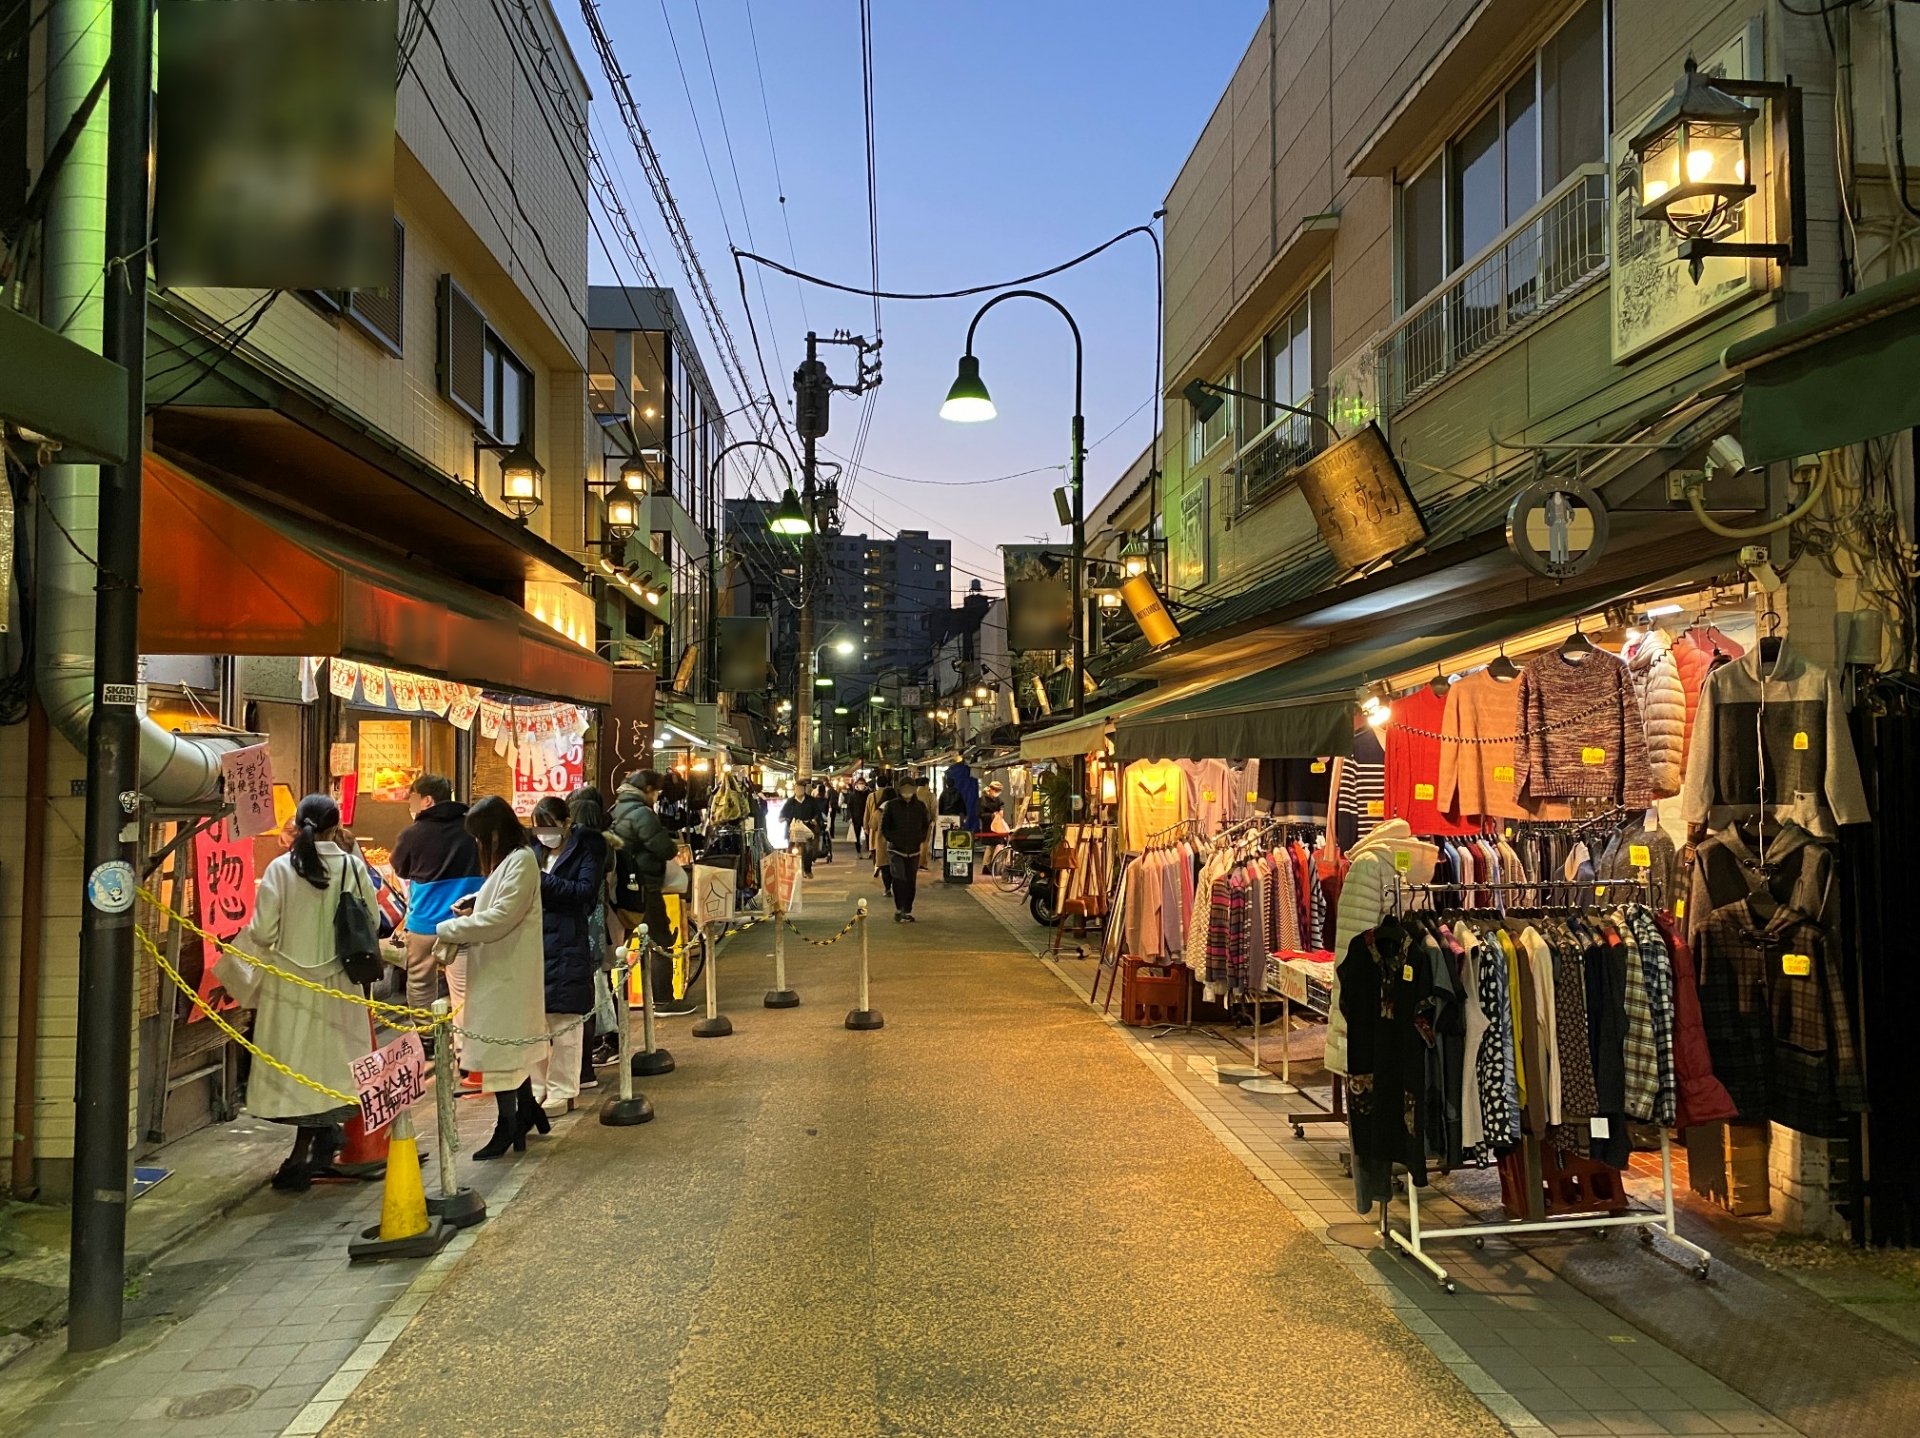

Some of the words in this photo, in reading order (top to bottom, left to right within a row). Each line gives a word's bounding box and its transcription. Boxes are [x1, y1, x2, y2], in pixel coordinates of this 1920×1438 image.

[332, 670, 349, 685] 50
[106, 686, 135, 695] SKATE
[365, 680, 378, 694] 50
[396, 687, 409, 700] 50
[447, 683, 460, 696] 50
[425, 688, 436, 700] 50
[453, 705, 468, 719] 50
[536, 723, 548, 732] 50
[532, 764, 568, 792] 50
[359, 1060, 426, 1132] 駐輪禁止
